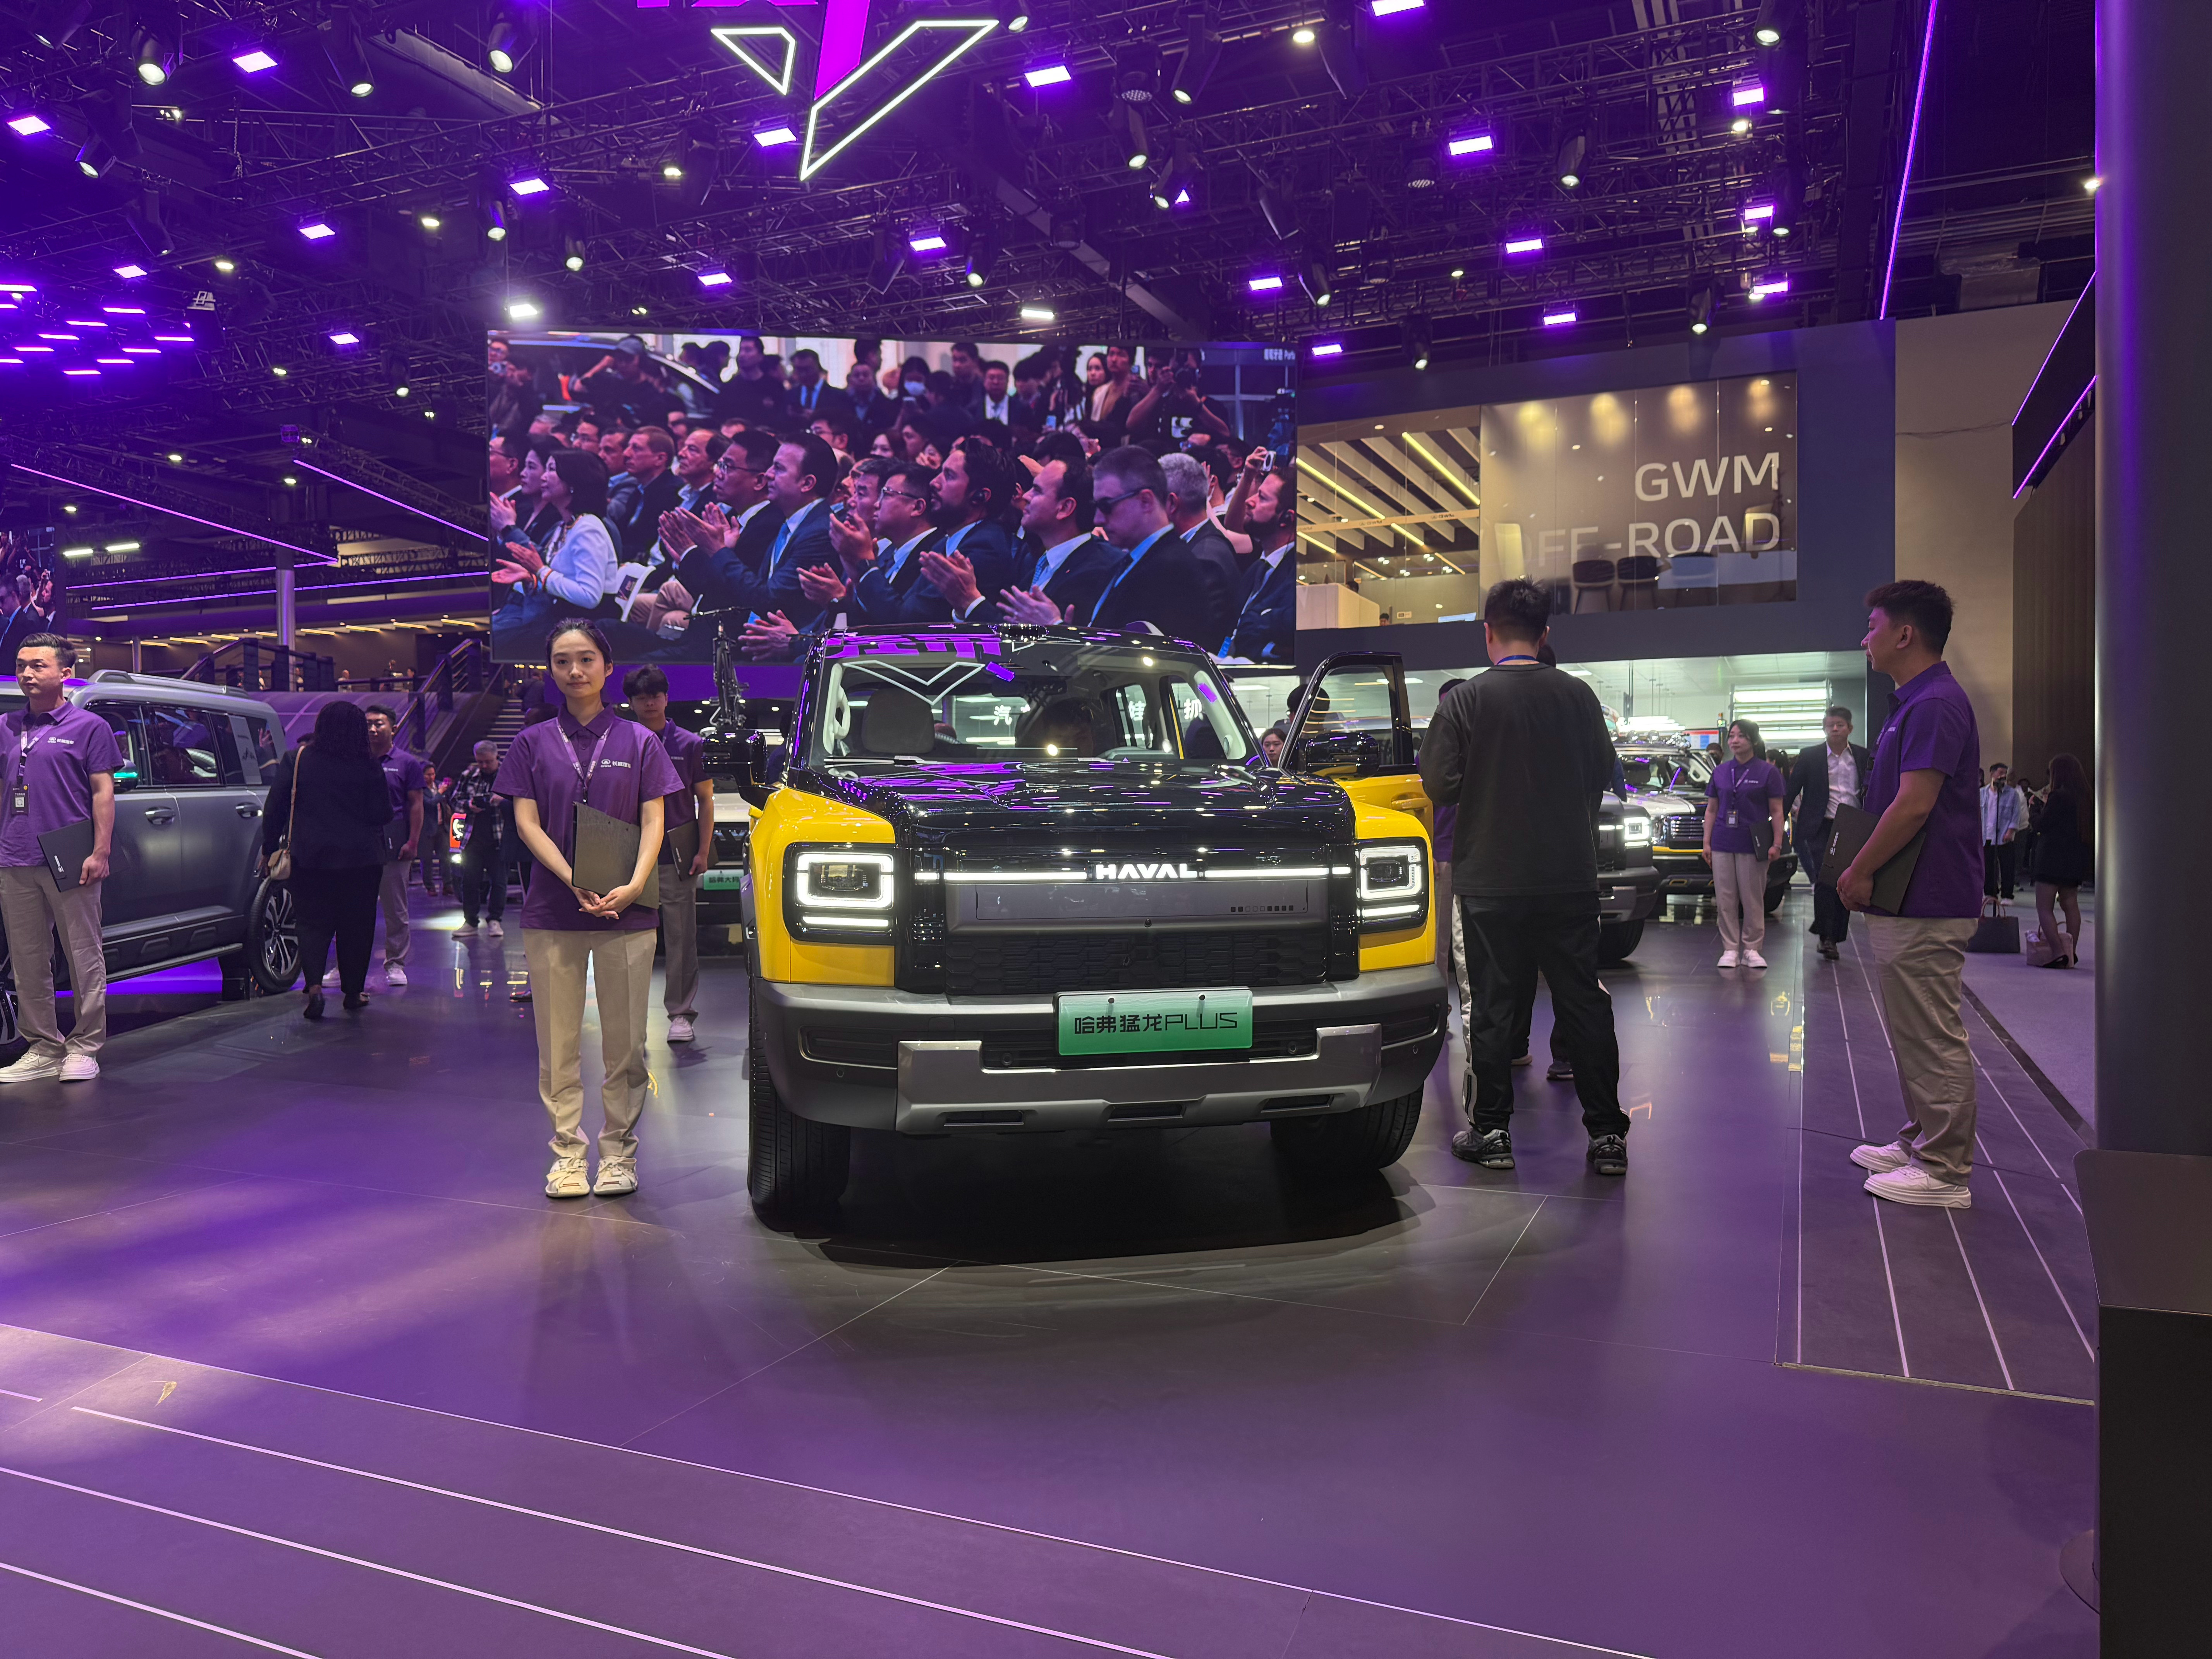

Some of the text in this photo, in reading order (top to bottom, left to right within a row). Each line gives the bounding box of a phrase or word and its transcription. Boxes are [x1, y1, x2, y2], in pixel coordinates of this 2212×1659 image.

[1635, 452, 1779, 502] GWM
[1503, 513, 1780, 568] FF-ROAD
[1096, 863, 1198, 879] HAVAL
[1074, 1012, 1238, 1034] 哈弗猛龙PLUS
